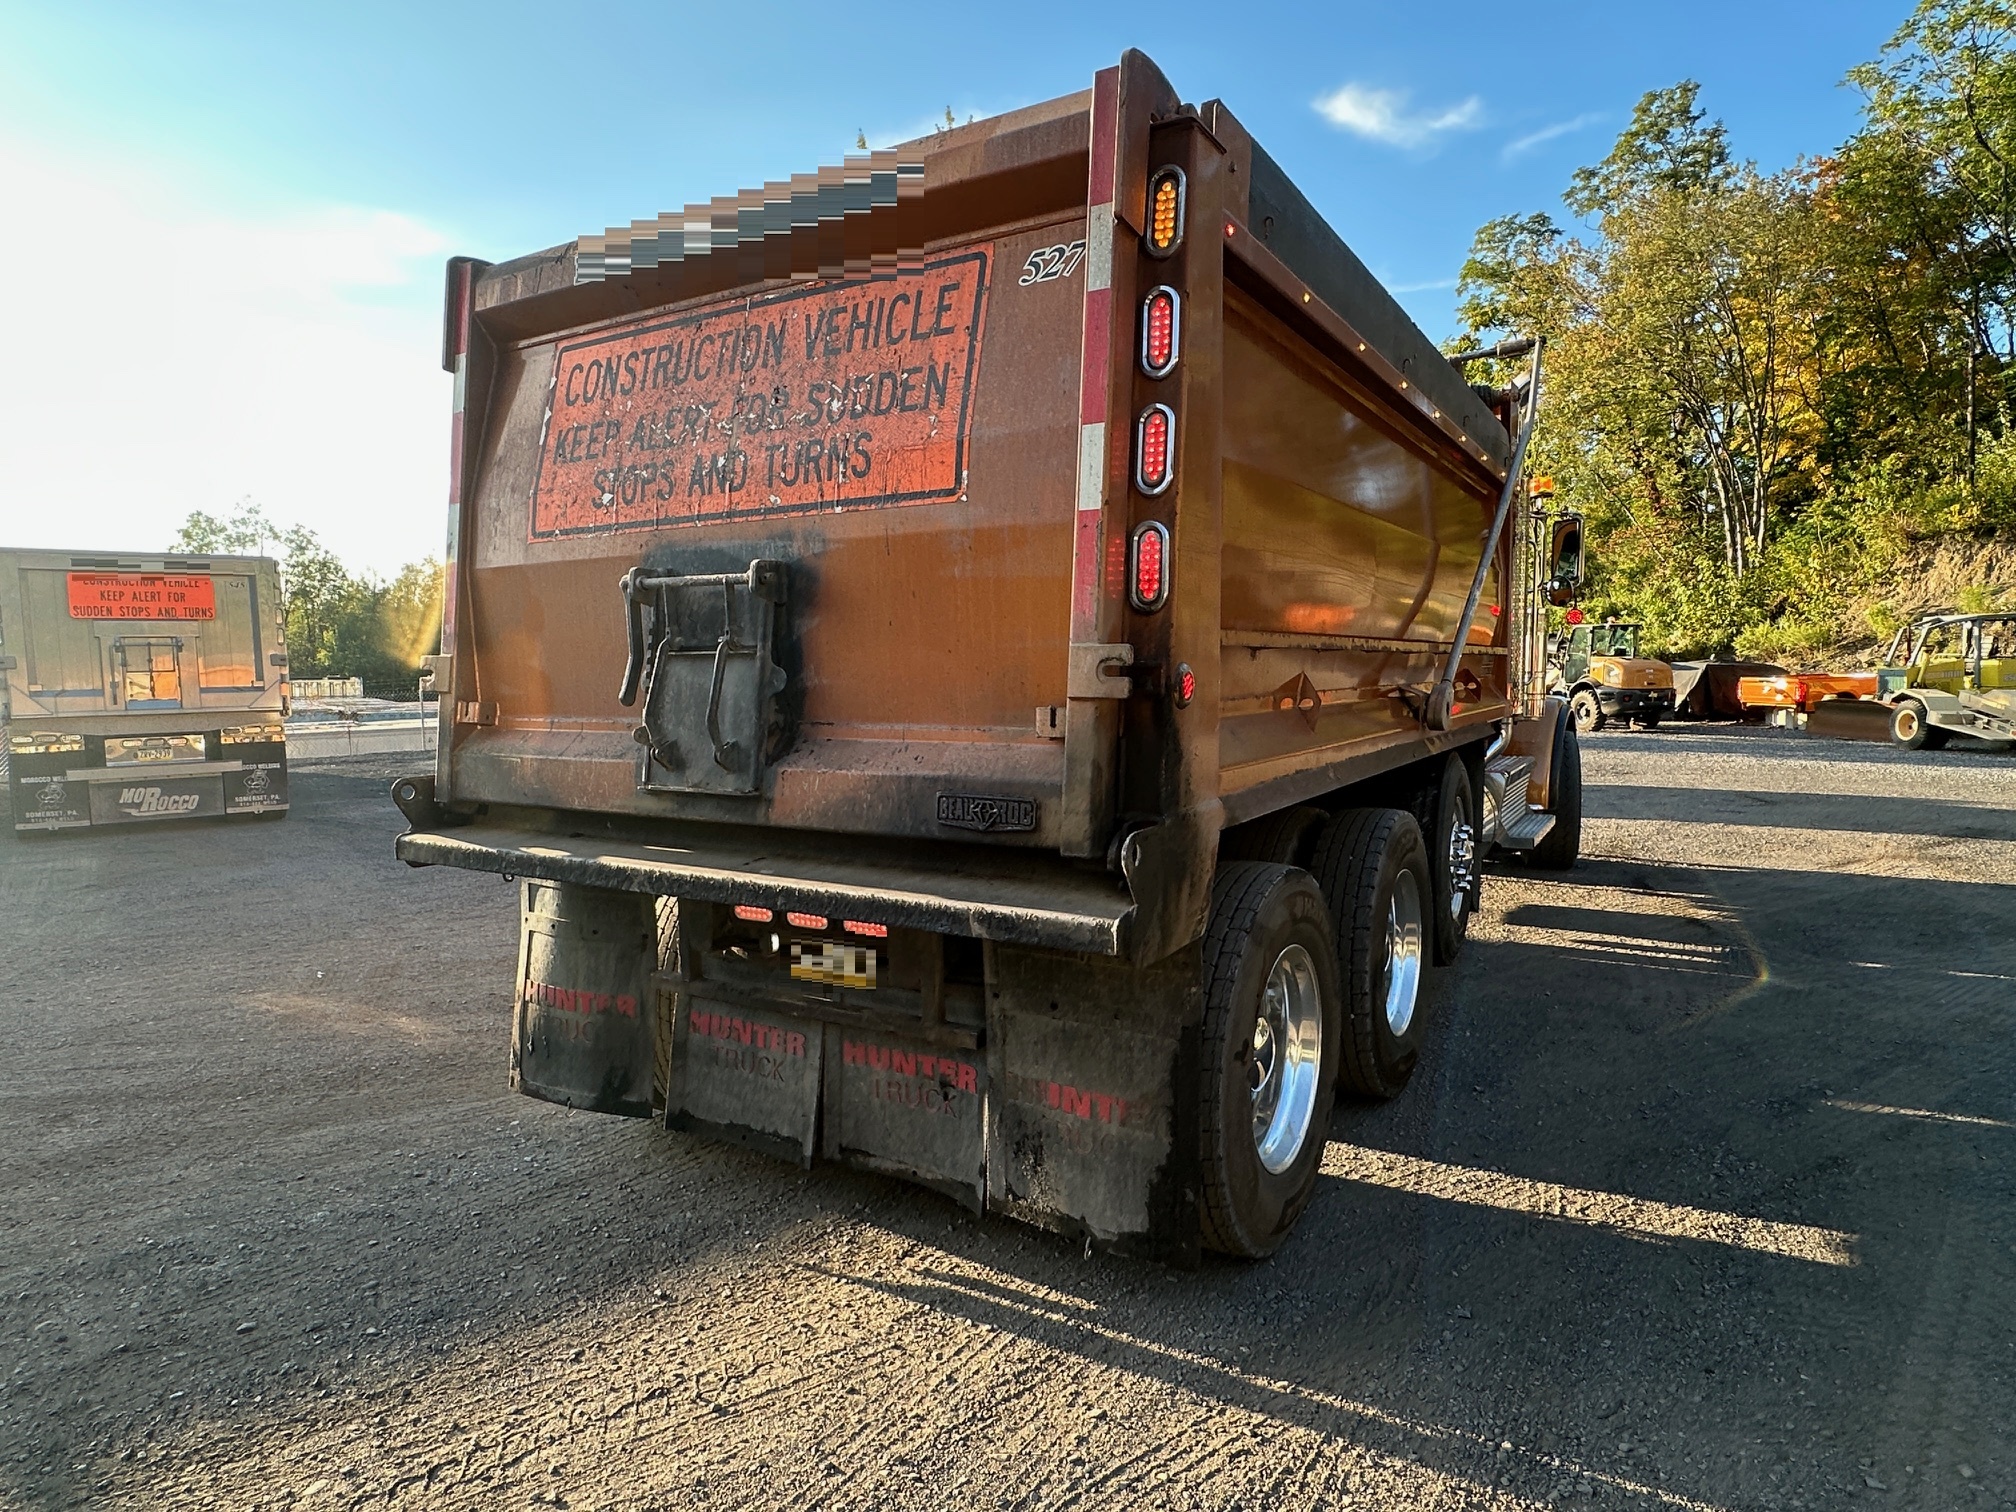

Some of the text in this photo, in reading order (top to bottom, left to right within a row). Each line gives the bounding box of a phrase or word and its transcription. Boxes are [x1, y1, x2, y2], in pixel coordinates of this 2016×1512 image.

[1018, 239, 1087, 286] 527
[566, 282, 960, 407] CONSTRUCTION VEHICLE
[552, 418, 620, 466] KEEP
[628, 400, 719, 450] ALERT
[804, 362, 951, 427] SUDDEN
[592, 431, 873, 510] STOPS AND TURNS
[73, 605, 213, 618] SUDDEN STOPS AND TURNS
[100, 590, 186, 603] KEEP ALERT FOR
[689, 1009, 807, 1059] HUNTER
[711, 1045, 785, 1082] TRUCK
[843, 1039, 979, 1095] HUNTER
